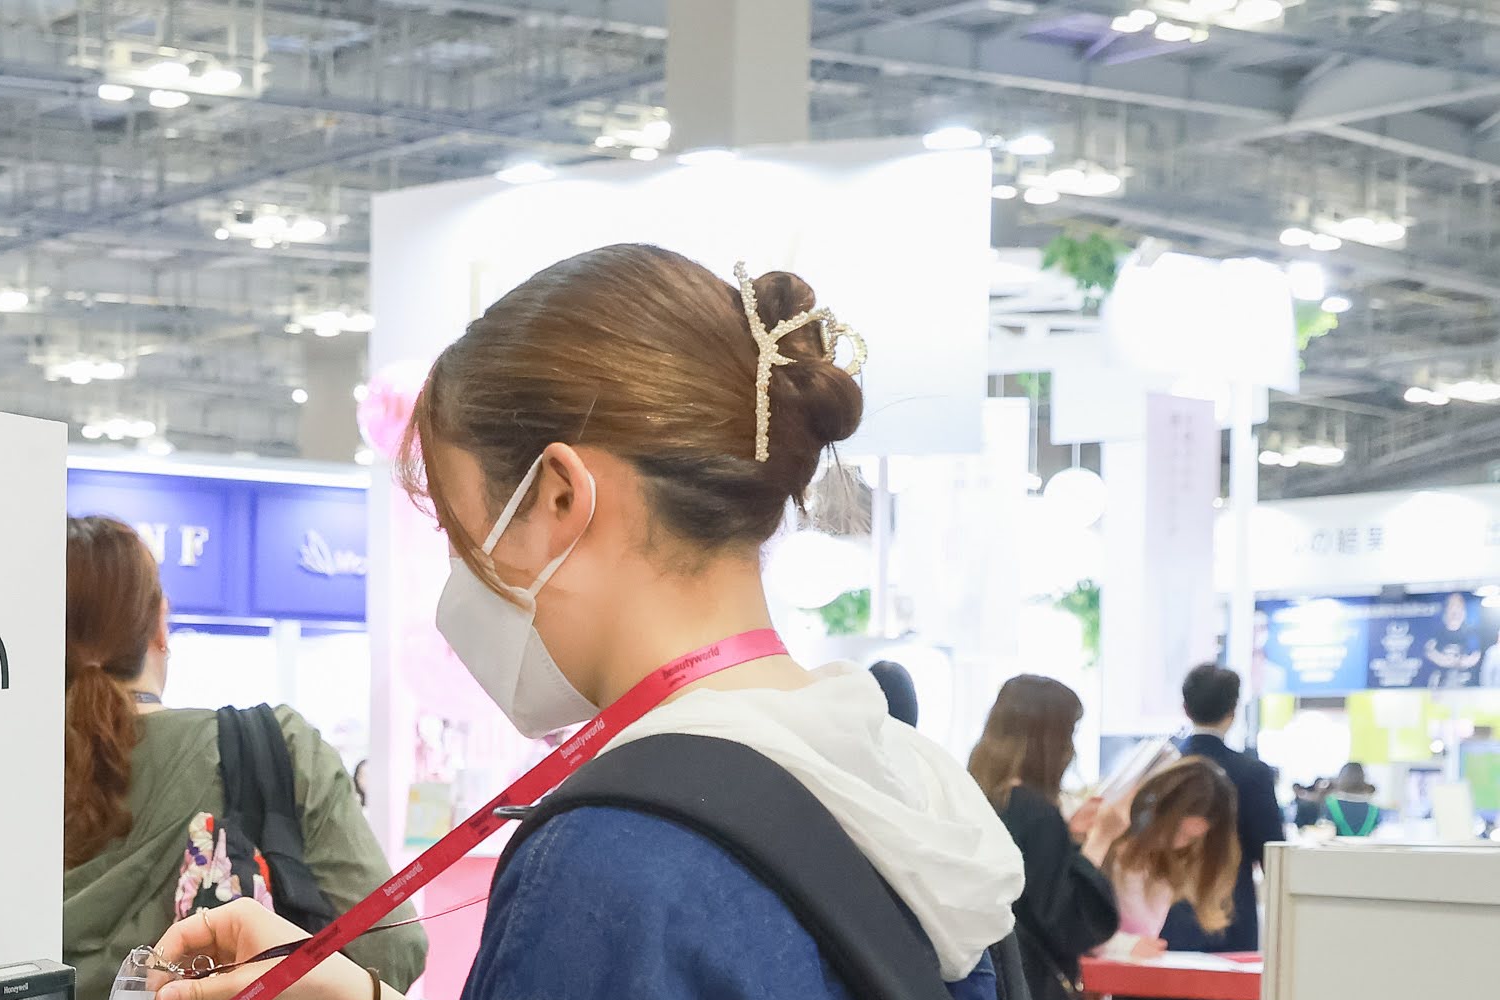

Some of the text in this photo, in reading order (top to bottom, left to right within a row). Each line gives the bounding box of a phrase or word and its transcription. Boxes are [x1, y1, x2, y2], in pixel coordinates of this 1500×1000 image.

[662, 646, 720, 680] beautyworld
[559, 717, 606, 760] beautyworld
[382, 861, 424, 897] beautyworld
[3, 982, 29, 995] Honeywell
